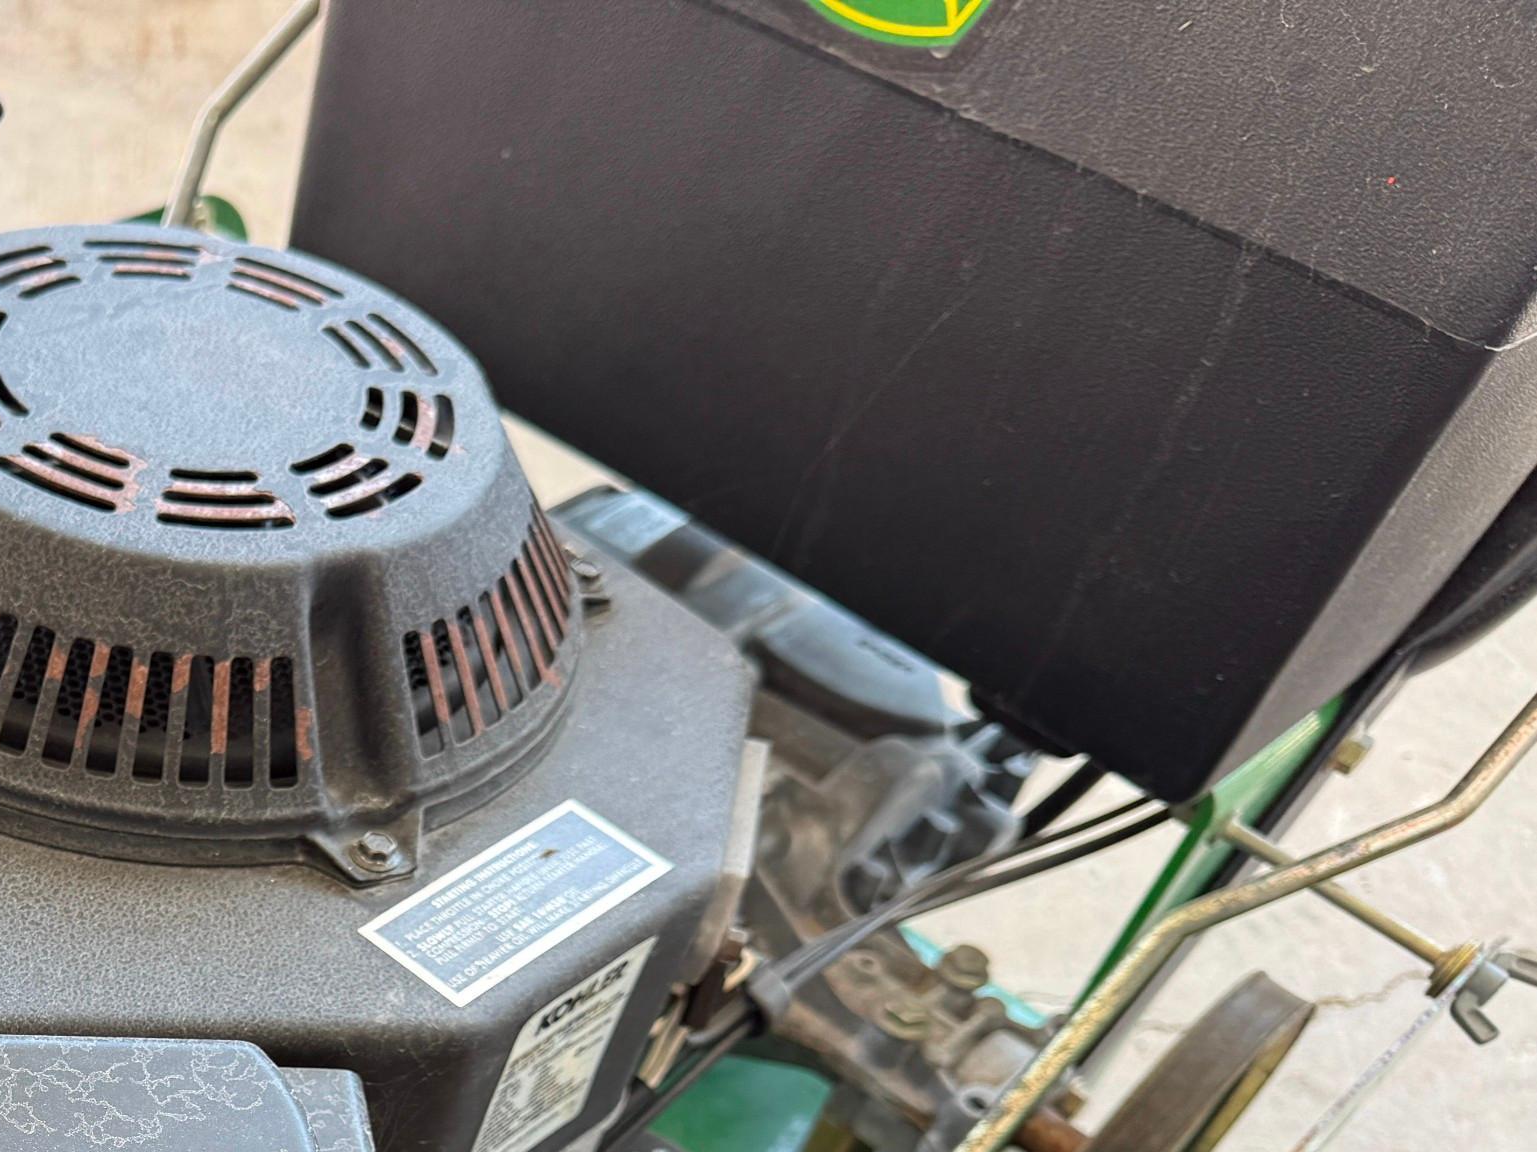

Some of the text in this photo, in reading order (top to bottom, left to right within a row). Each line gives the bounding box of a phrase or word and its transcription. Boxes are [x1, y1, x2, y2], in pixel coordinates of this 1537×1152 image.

[429, 878, 478, 909] STARTING
[430, 897, 474, 926] THROTTLE
[414, 924, 457, 952] SLOWLY
[432, 948, 459, 966] PULL
